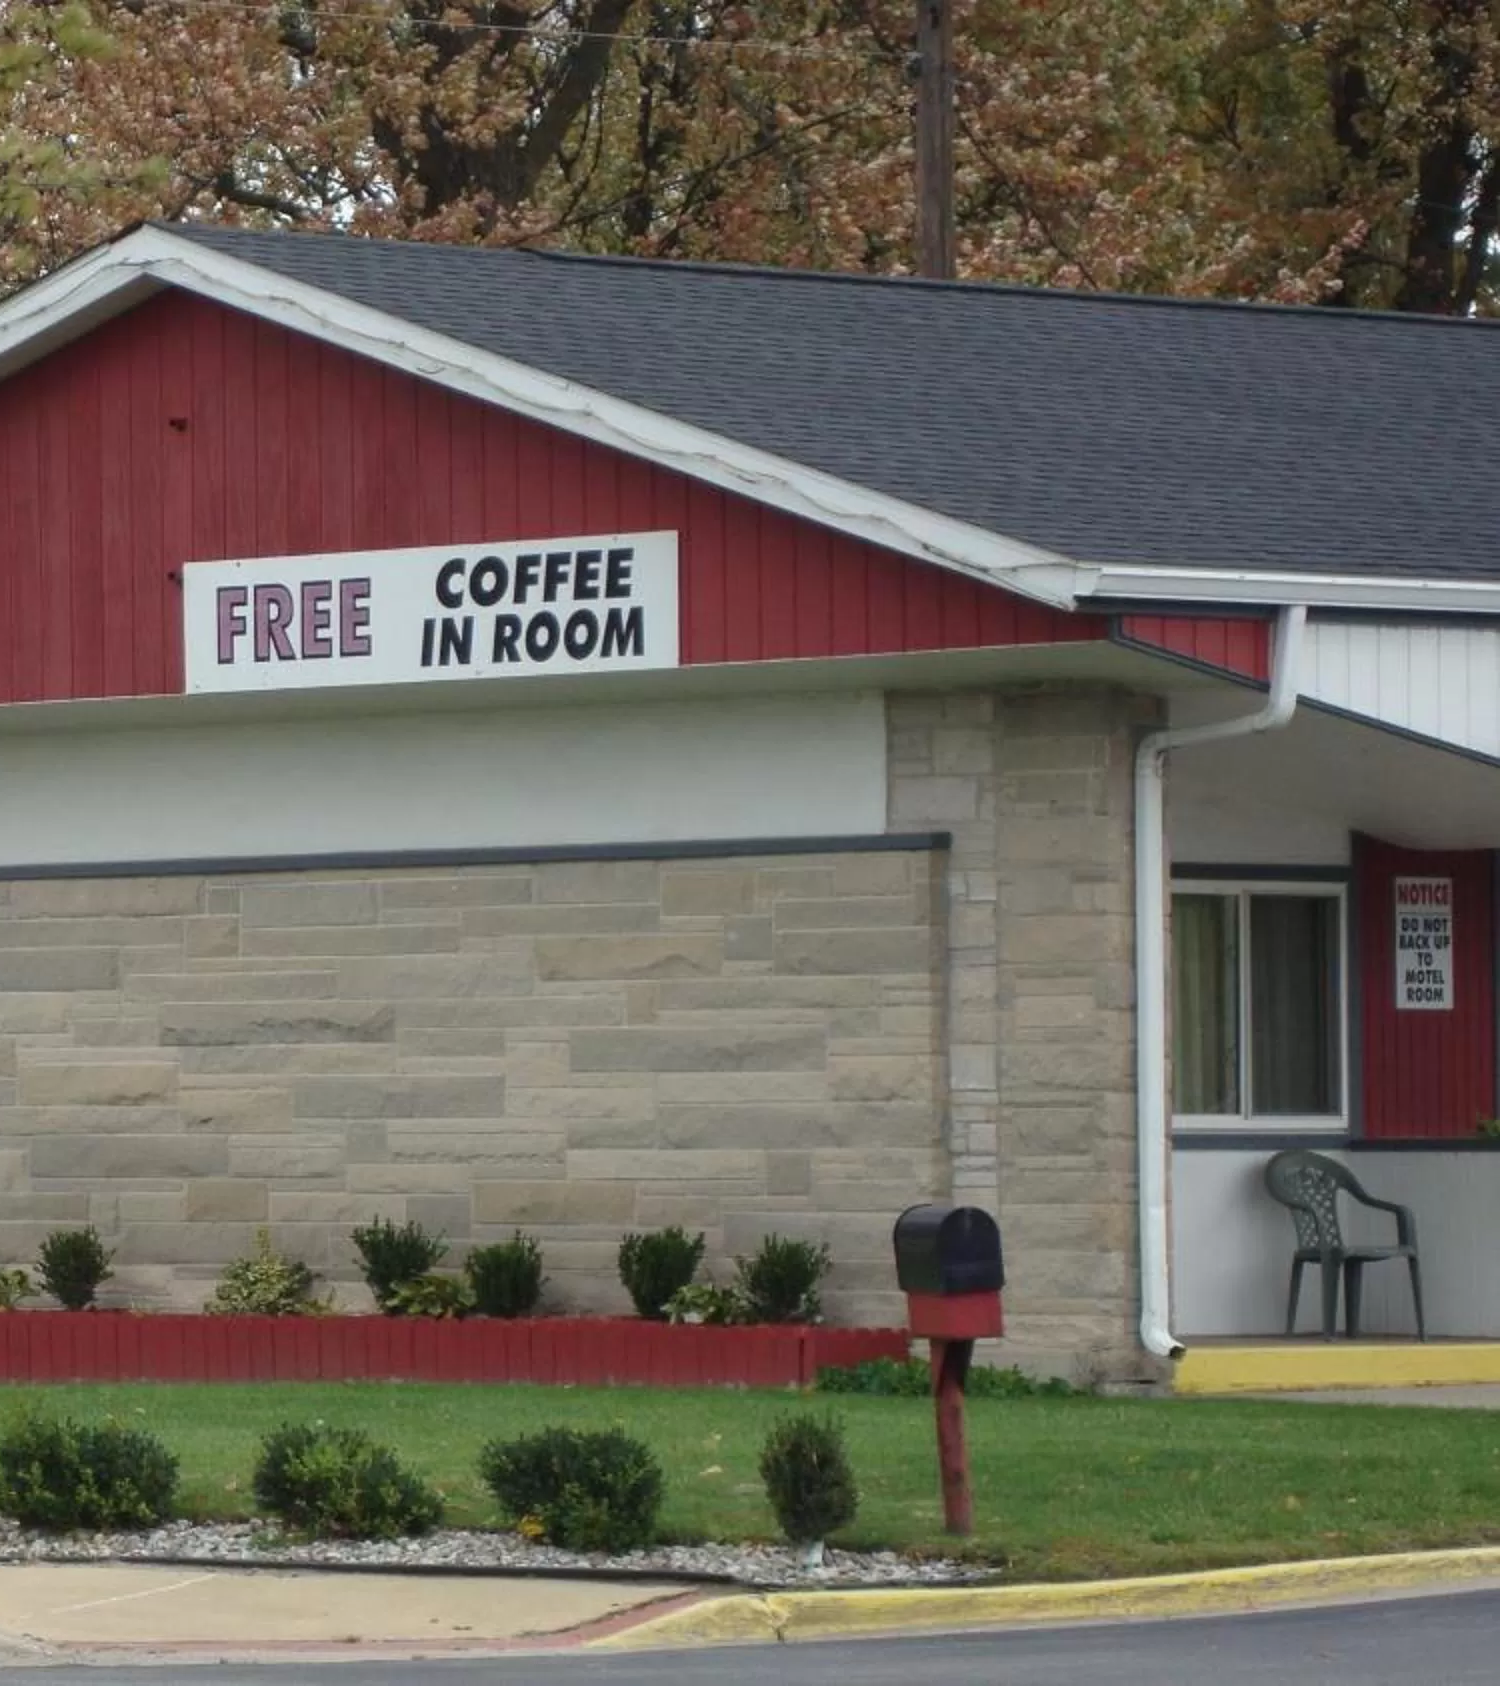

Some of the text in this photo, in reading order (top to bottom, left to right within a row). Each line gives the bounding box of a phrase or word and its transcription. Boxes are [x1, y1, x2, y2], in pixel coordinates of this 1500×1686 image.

[435, 547, 634, 608] COFFEE
[215, 576, 372, 665] FREE
[420, 606, 644, 667] IN ROOM
[1397, 884, 1449, 905] NOTICE
[1401, 917, 1448, 932] DO NOT
[1399, 934, 1450, 949] BACK UP
[1417, 951, 1433, 966] TO
[1405, 969, 1444, 984] MOTEL
[1406, 987, 1443, 1002] ROOM
